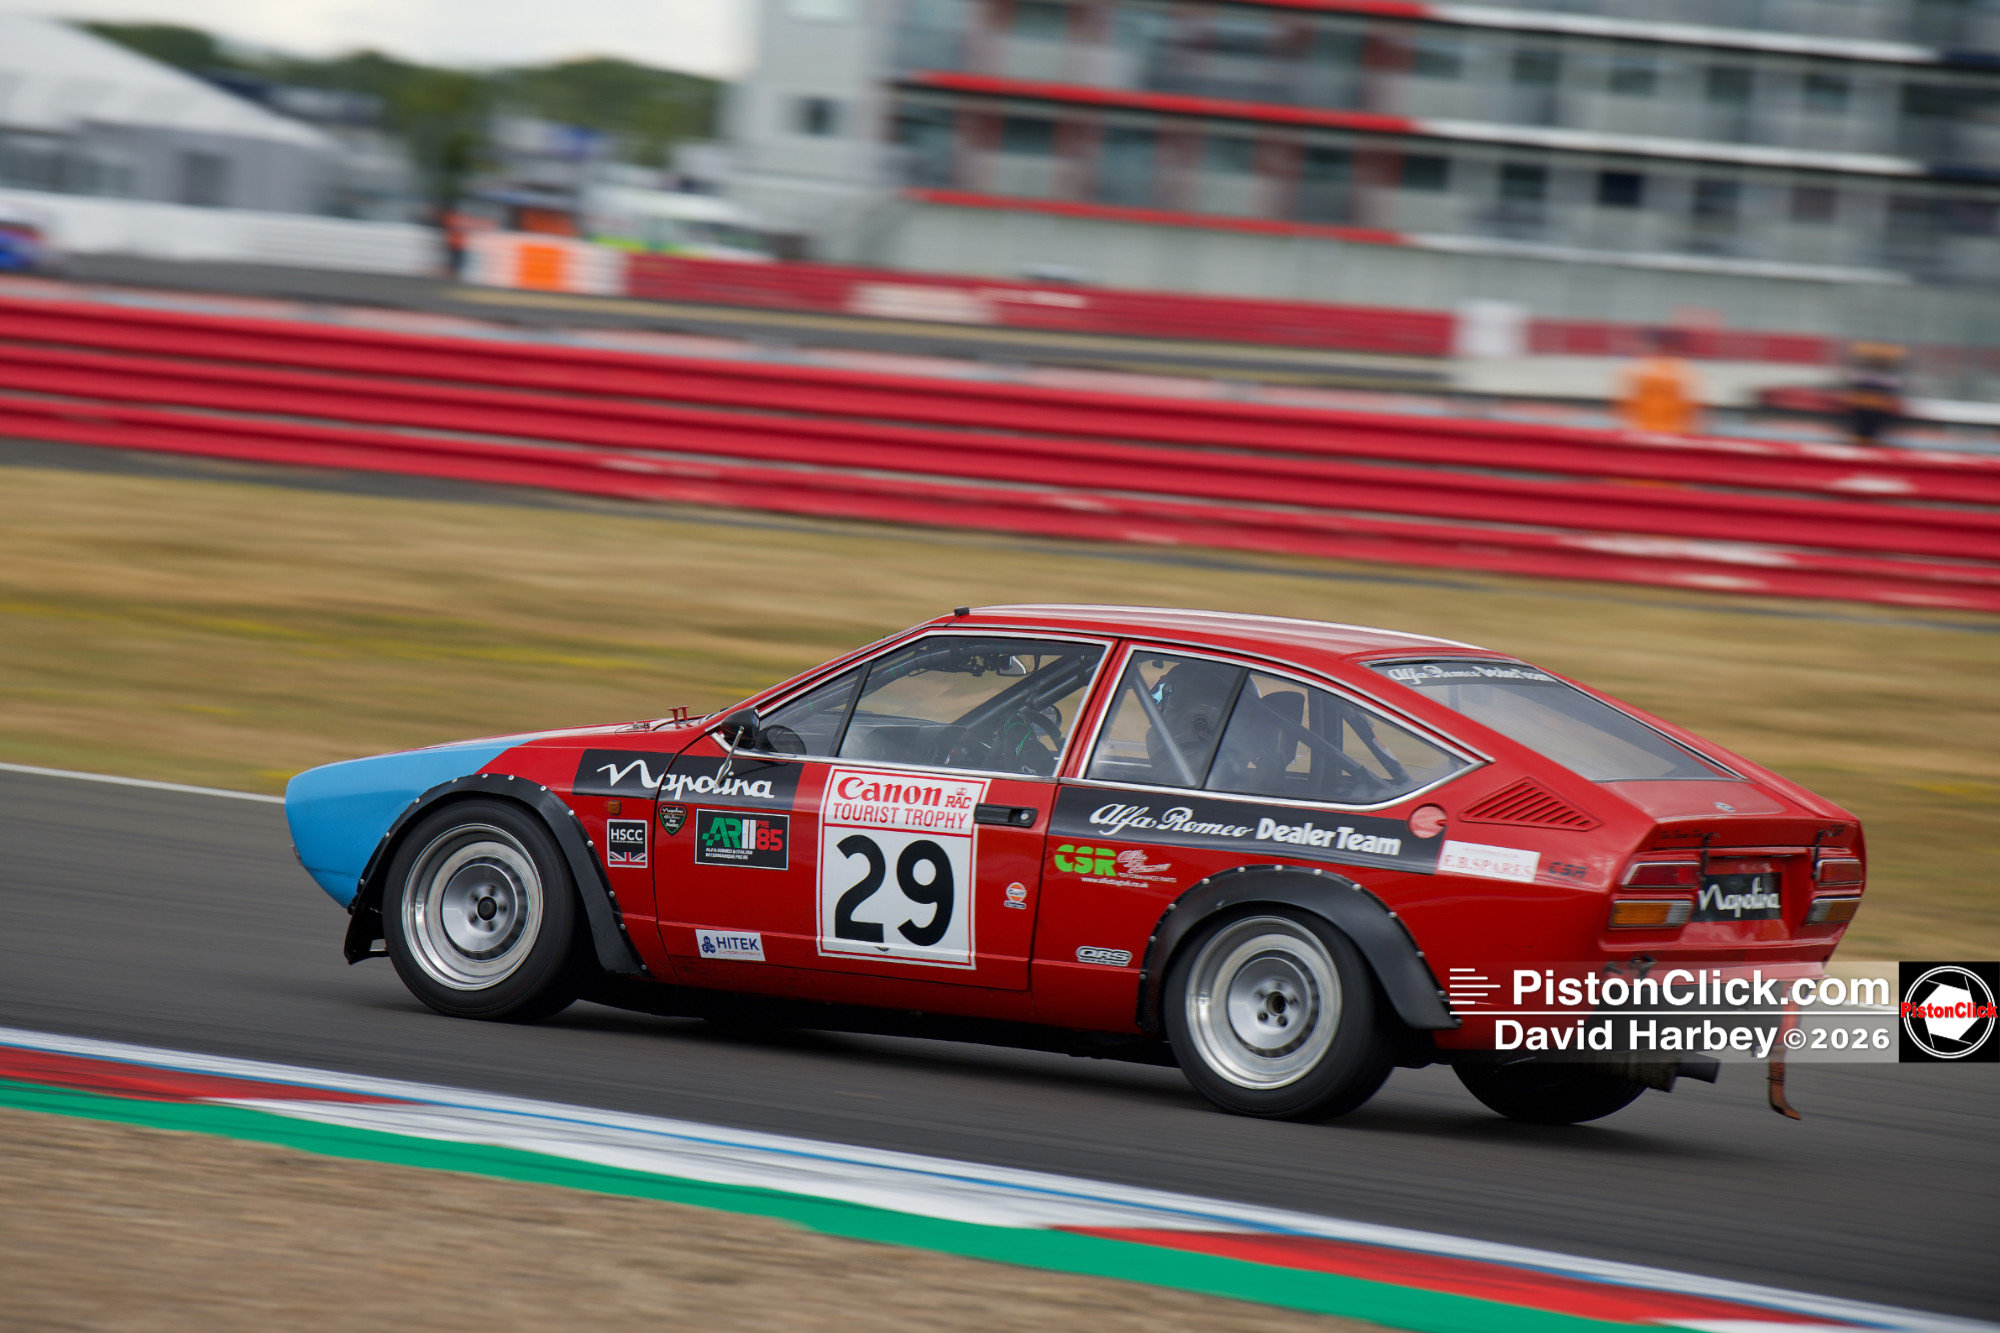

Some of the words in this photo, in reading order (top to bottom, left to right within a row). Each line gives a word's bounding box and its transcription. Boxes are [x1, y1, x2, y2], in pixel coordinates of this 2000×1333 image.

[837, 776, 942, 807] Canon
[945, 795, 972, 809] RAC
[756, 820, 770, 828] PRE
[833, 802, 900, 824] TOURIST
[904, 808, 968, 829] TROPHY
[611, 829, 643, 841] HSCC
[756, 828, 783, 851] 85
[1089, 803, 1157, 836] Alfa
[1157, 807, 1254, 838] Romeo
[1256, 817, 1339, 847] Dealer
[1336, 826, 1402, 856] Team
[1055, 844, 1117, 877] CSR
[834, 834, 955, 947] 29
[716, 936, 760, 951] HITEK
